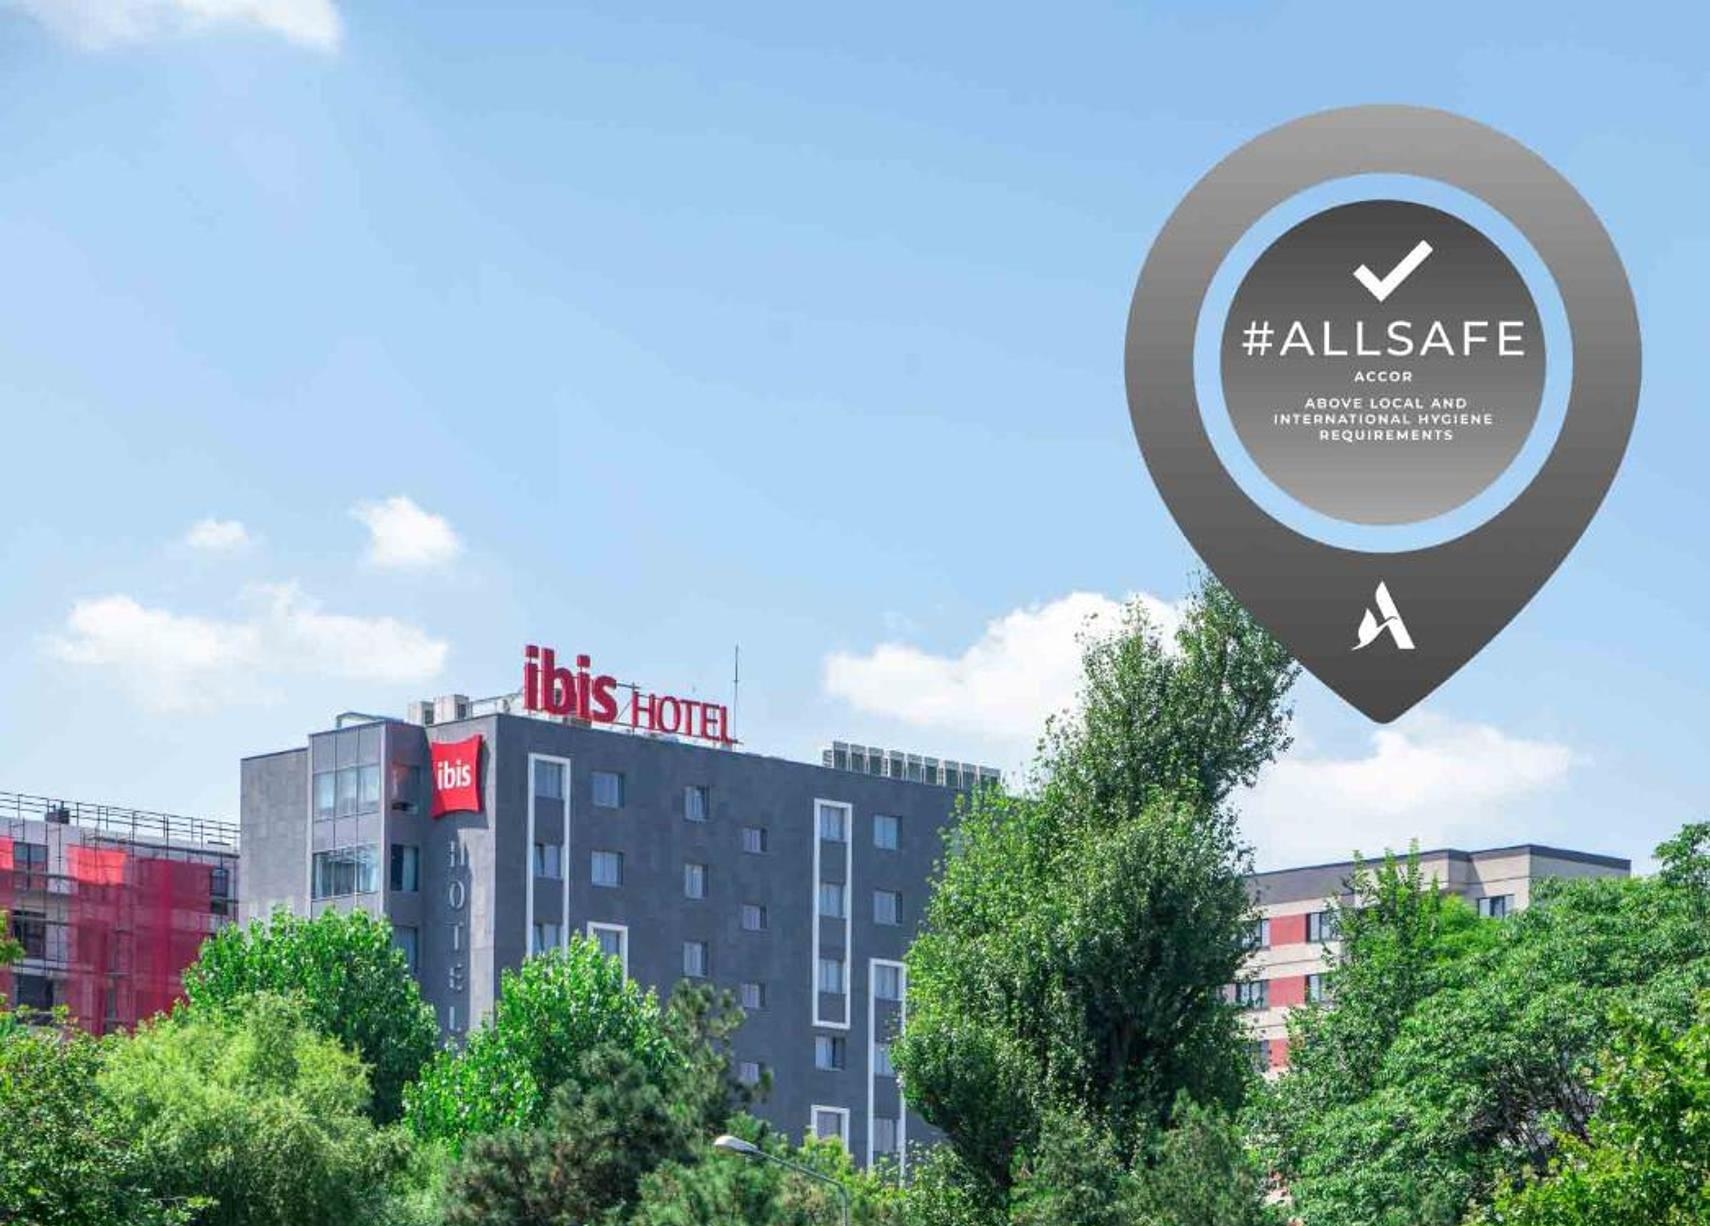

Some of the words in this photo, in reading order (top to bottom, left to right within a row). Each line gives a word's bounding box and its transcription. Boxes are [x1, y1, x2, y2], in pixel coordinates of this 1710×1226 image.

[523, 644, 619, 724] ibis
[631, 690, 734, 743] HOTEL
[437, 758, 472, 792] ibis
[448, 839, 467, 1032] HOTEL
